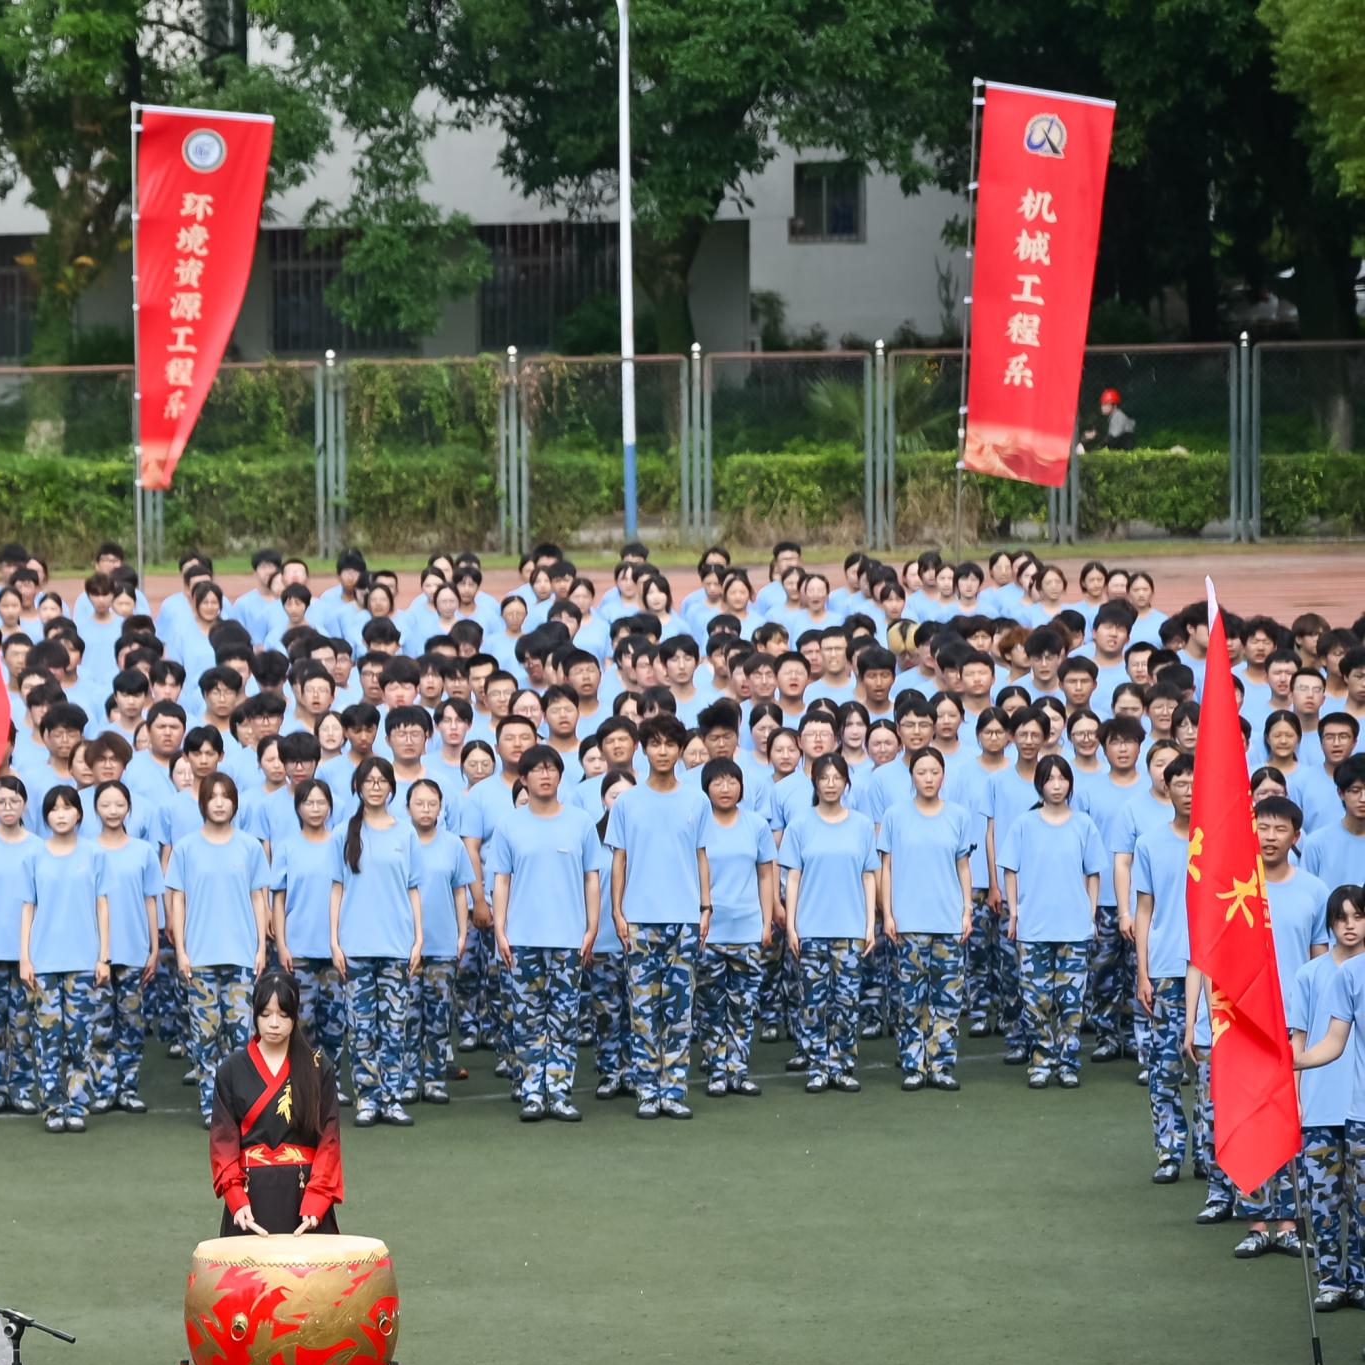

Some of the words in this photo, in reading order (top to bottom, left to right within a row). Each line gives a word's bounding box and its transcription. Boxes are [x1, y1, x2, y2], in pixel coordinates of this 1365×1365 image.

[163, 192, 214, 420] 环境资源工程系
[1003, 188, 1058, 389] 机械工程系
